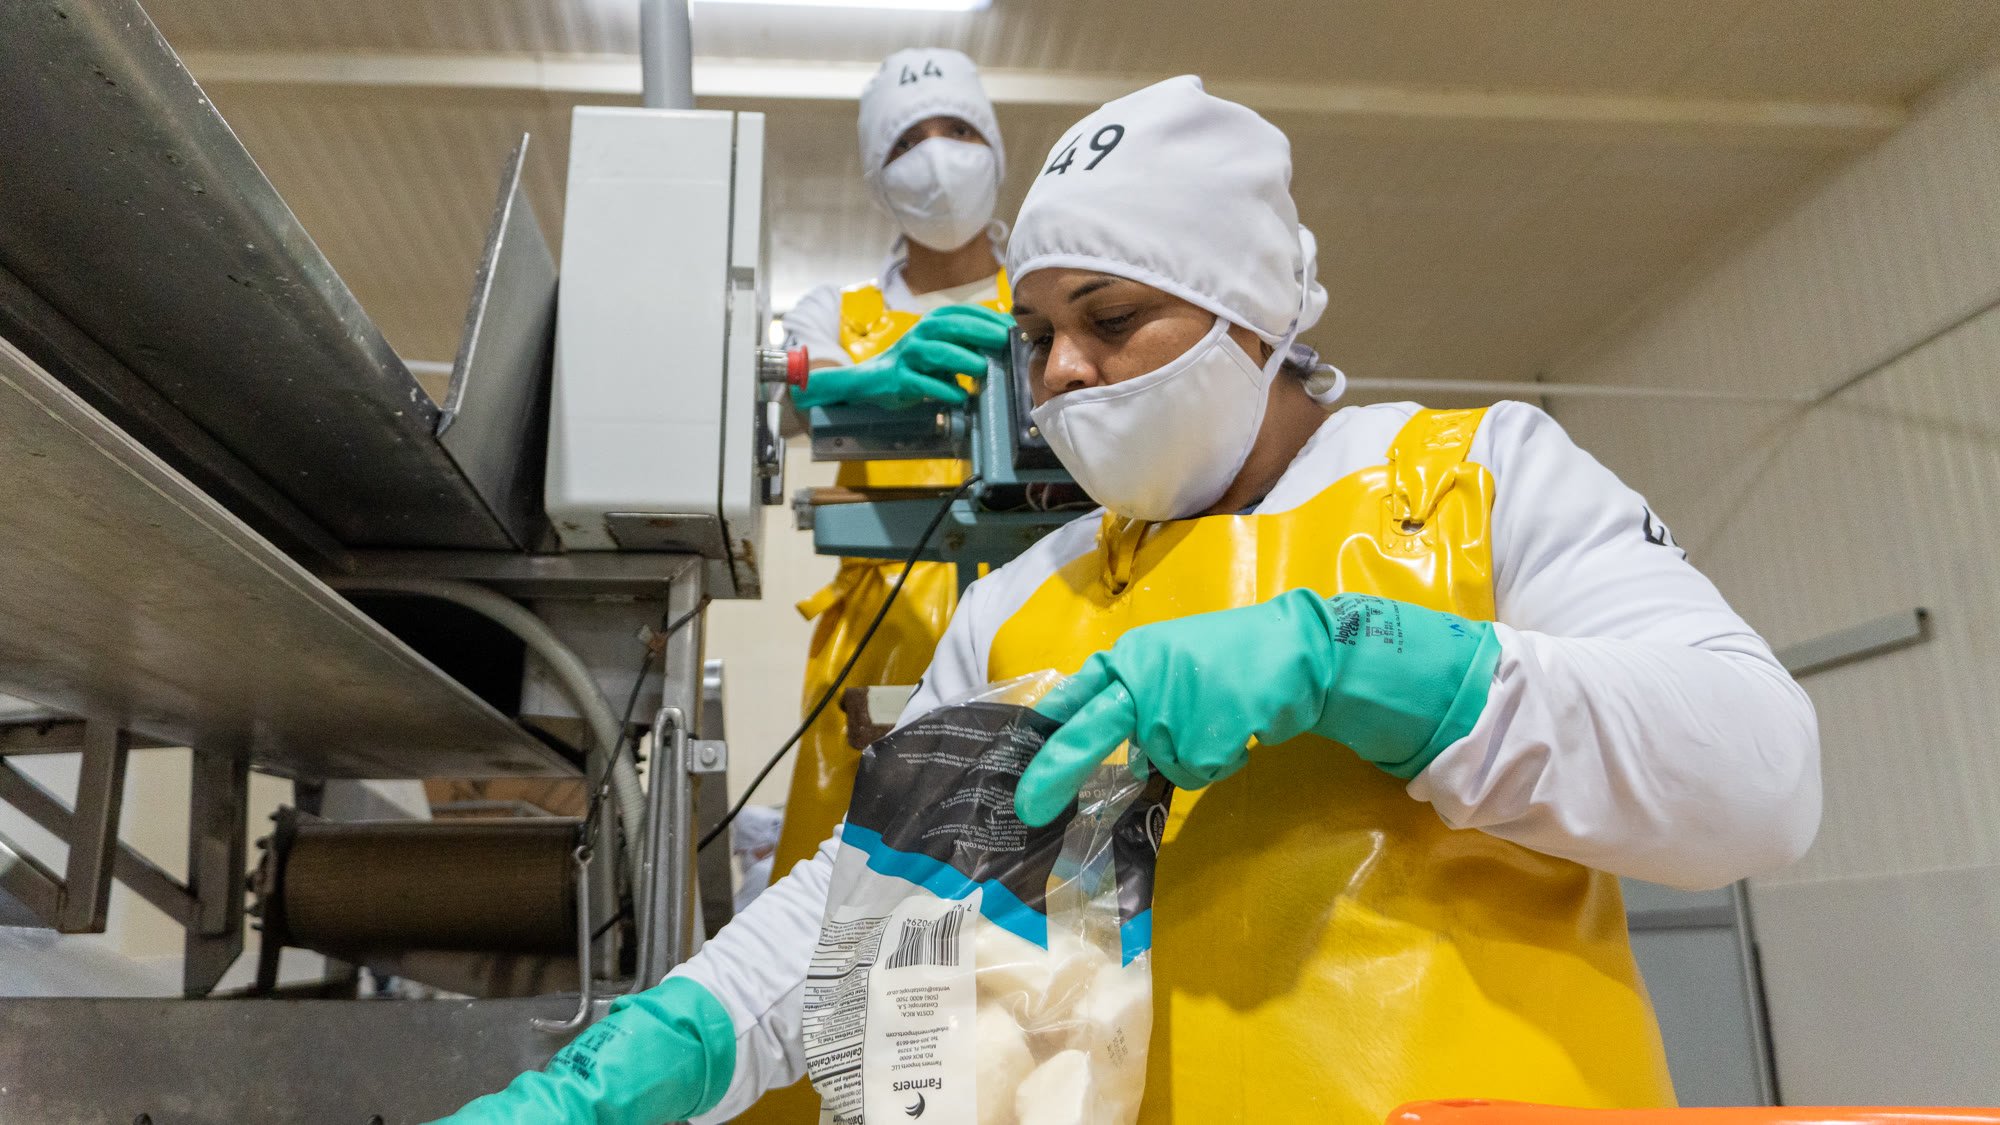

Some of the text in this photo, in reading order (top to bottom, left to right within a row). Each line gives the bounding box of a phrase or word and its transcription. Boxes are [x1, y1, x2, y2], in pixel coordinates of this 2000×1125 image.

[898, 60, 944, 86] 44
[1045, 122, 1126, 176] 49
[892, 1078, 942, 1092] Farmers
